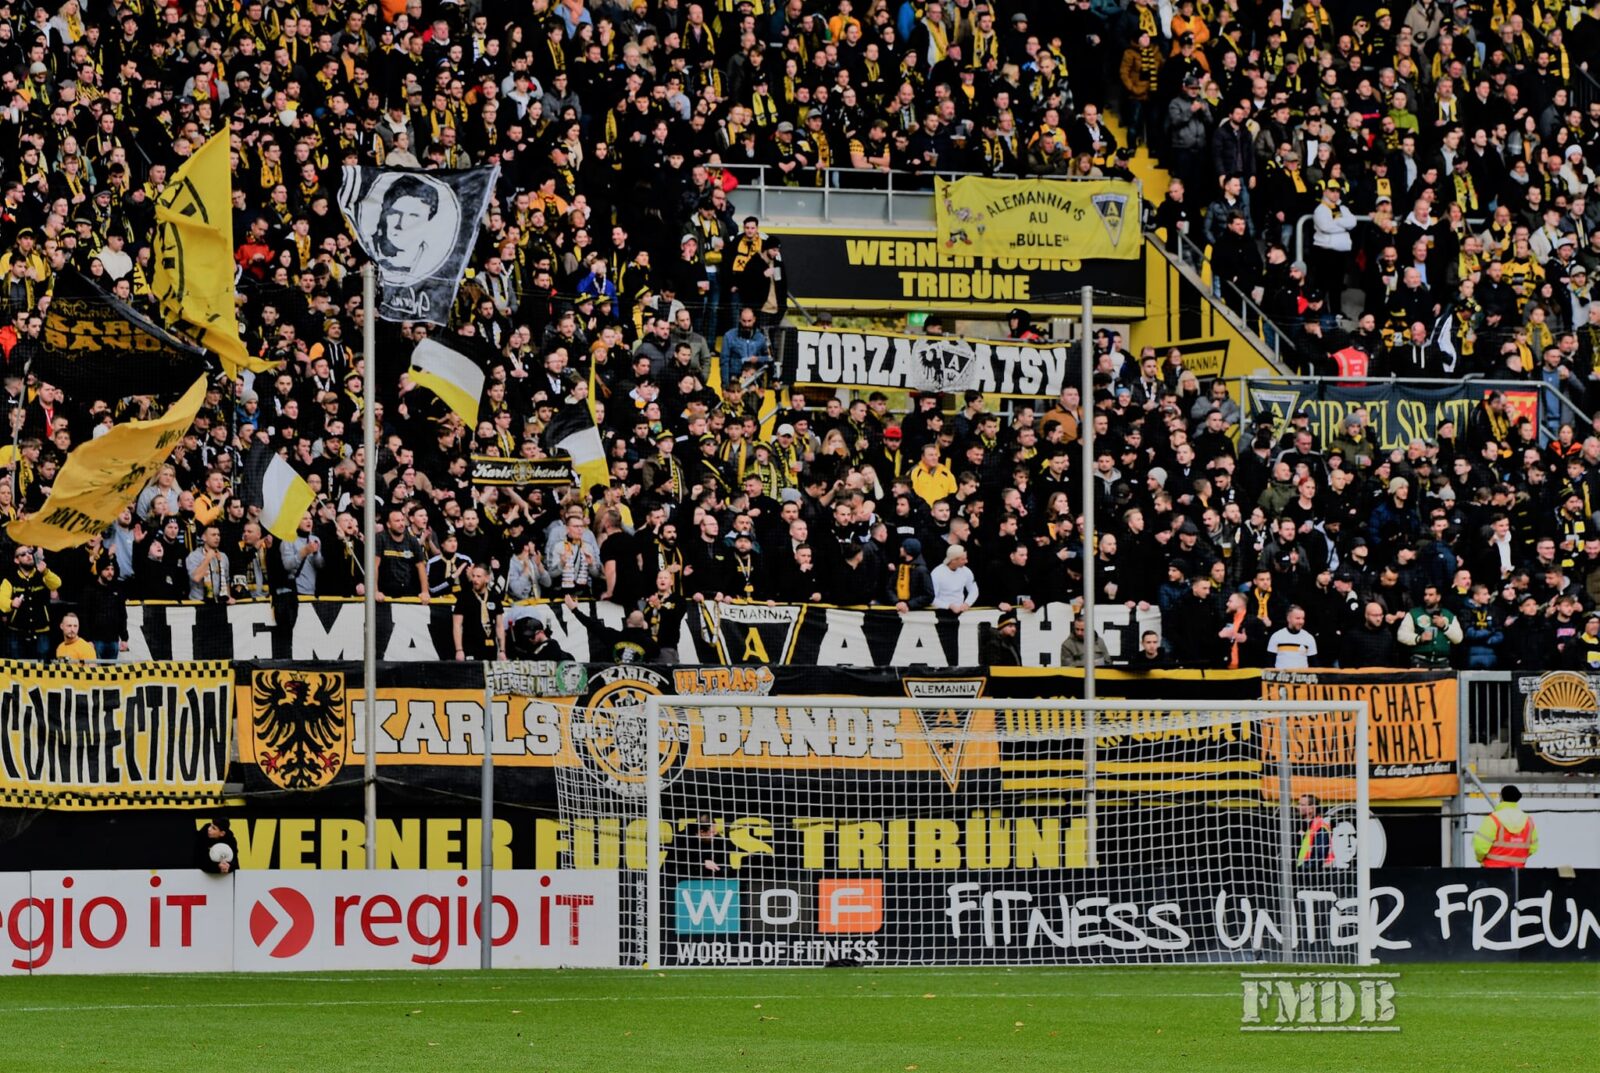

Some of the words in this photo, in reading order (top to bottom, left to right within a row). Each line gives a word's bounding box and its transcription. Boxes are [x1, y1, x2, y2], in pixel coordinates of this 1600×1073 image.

[985, 191, 1086, 222] ALEMANNIA'S
[1029, 211, 1048, 224] AU
[898, 269, 1031, 300] TRIBÜNE
[796, 330, 914, 388] FORZA
[974, 342, 1068, 396] ATSV
[673, 667, 758, 695] ULTRAS
[914, 684, 977, 695] ALEMANNIA
[1, 683, 229, 784] CONNECTION
[351, 699, 562, 755] KARLS
[699, 702, 904, 759] BANDE
[1538, 734, 1593, 754] TIVOLI
[334, 875, 519, 965] regio
[946, 882, 1191, 950] FITNESS
[1215, 886, 1412, 950] UNTER
[677, 942, 752, 964] WORLD
[759, 941, 788, 963] OF
[792, 940, 880, 963] FITNESS
